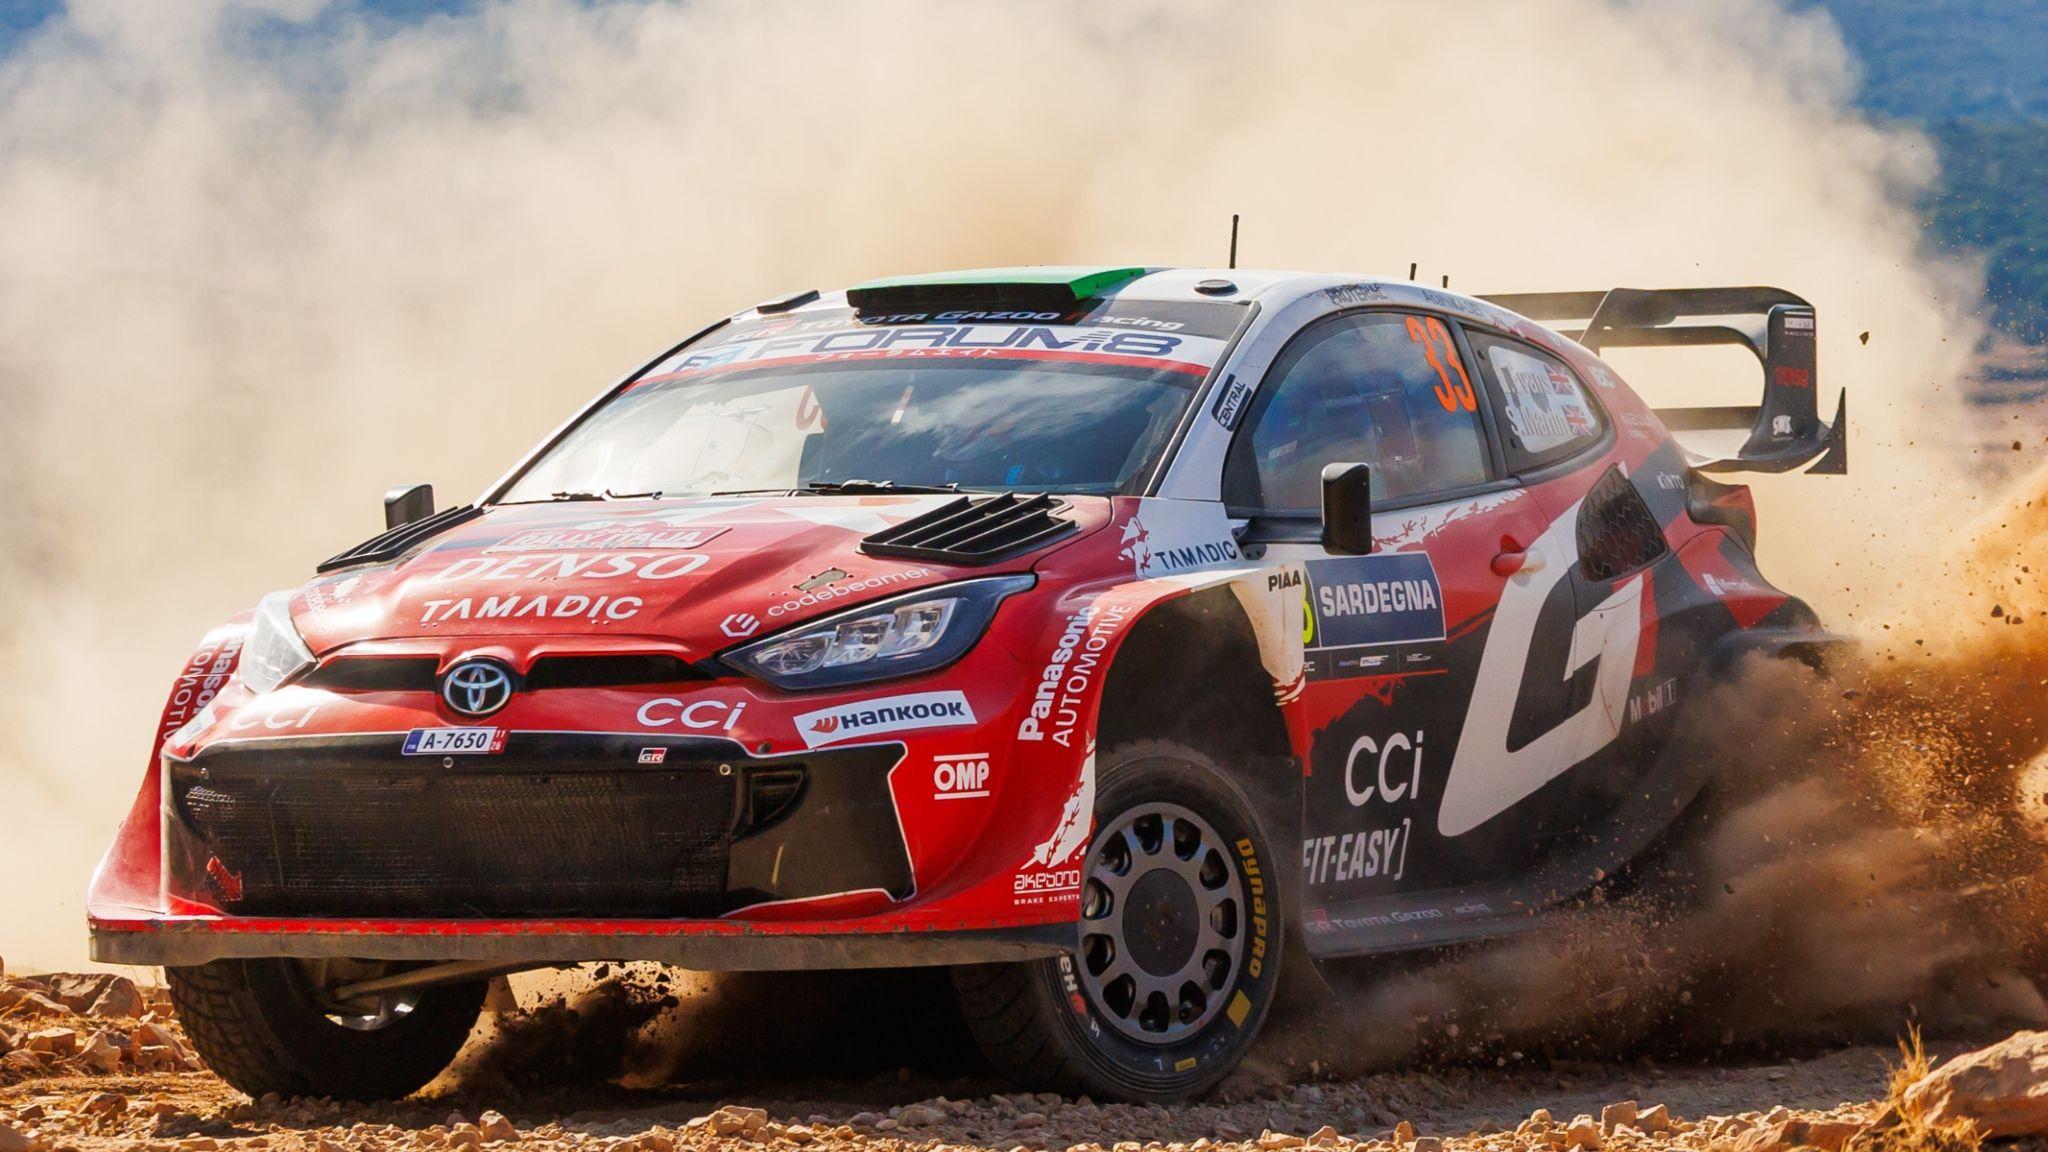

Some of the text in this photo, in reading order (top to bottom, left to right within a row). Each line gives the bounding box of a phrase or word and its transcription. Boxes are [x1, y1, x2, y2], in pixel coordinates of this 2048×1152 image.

[934, 311, 1060, 322] GAZOO
[750, 326, 1182, 358] FORUM8
[1405, 316, 1476, 413] 33
[1217, 381, 1246, 428] CENTRAL
[430, 552, 711, 583] DENSO
[1155, 540, 1238, 570] TAMADIC
[767, 567, 930, 617] codebeamer
[1268, 570, 1302, 592] PIAA
[421, 595, 643, 622] TAMADIC
[1319, 579, 1437, 618] SARDEGNA
[1017, 605, 1101, 741] Panasonic
[1052, 605, 1132, 748] AUTOMOTIVE
[637, 698, 747, 730] CCi
[423, 732, 488, 749] A-7650
[641, 752, 664, 763] GR
[1345, 730, 1424, 807] CCi
[933, 760, 990, 791] OMP
[1014, 894, 1080, 905] BRAKE EXPERTS
